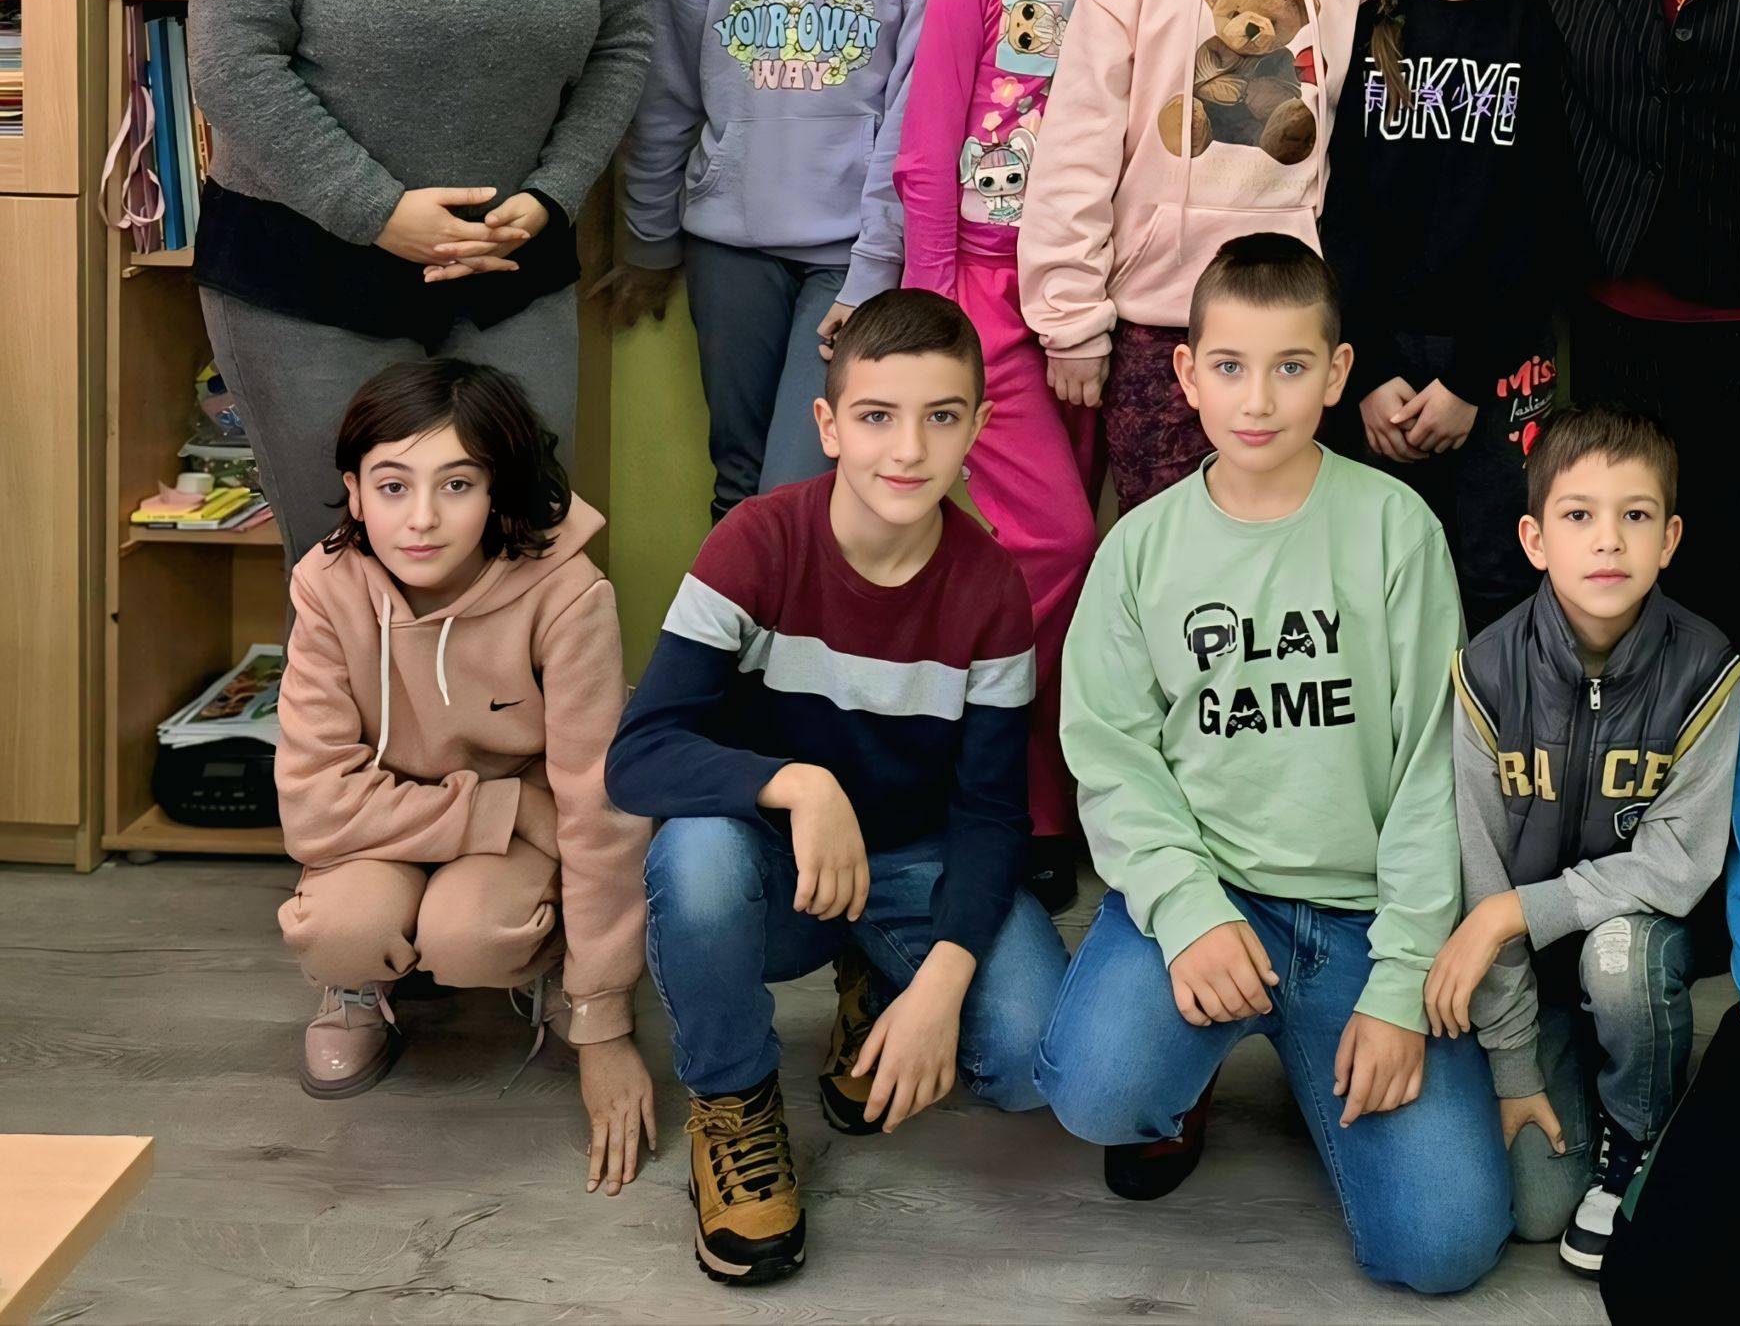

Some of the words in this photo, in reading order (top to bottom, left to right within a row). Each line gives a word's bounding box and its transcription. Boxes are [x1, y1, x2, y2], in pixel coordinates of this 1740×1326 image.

[712, 2, 789, 49] YOUR
[796, 2, 882, 52] OWN
[752, 58, 831, 91] WAY
[1185, 607, 1341, 672] PLAY
[1198, 678, 1356, 739] GAME
